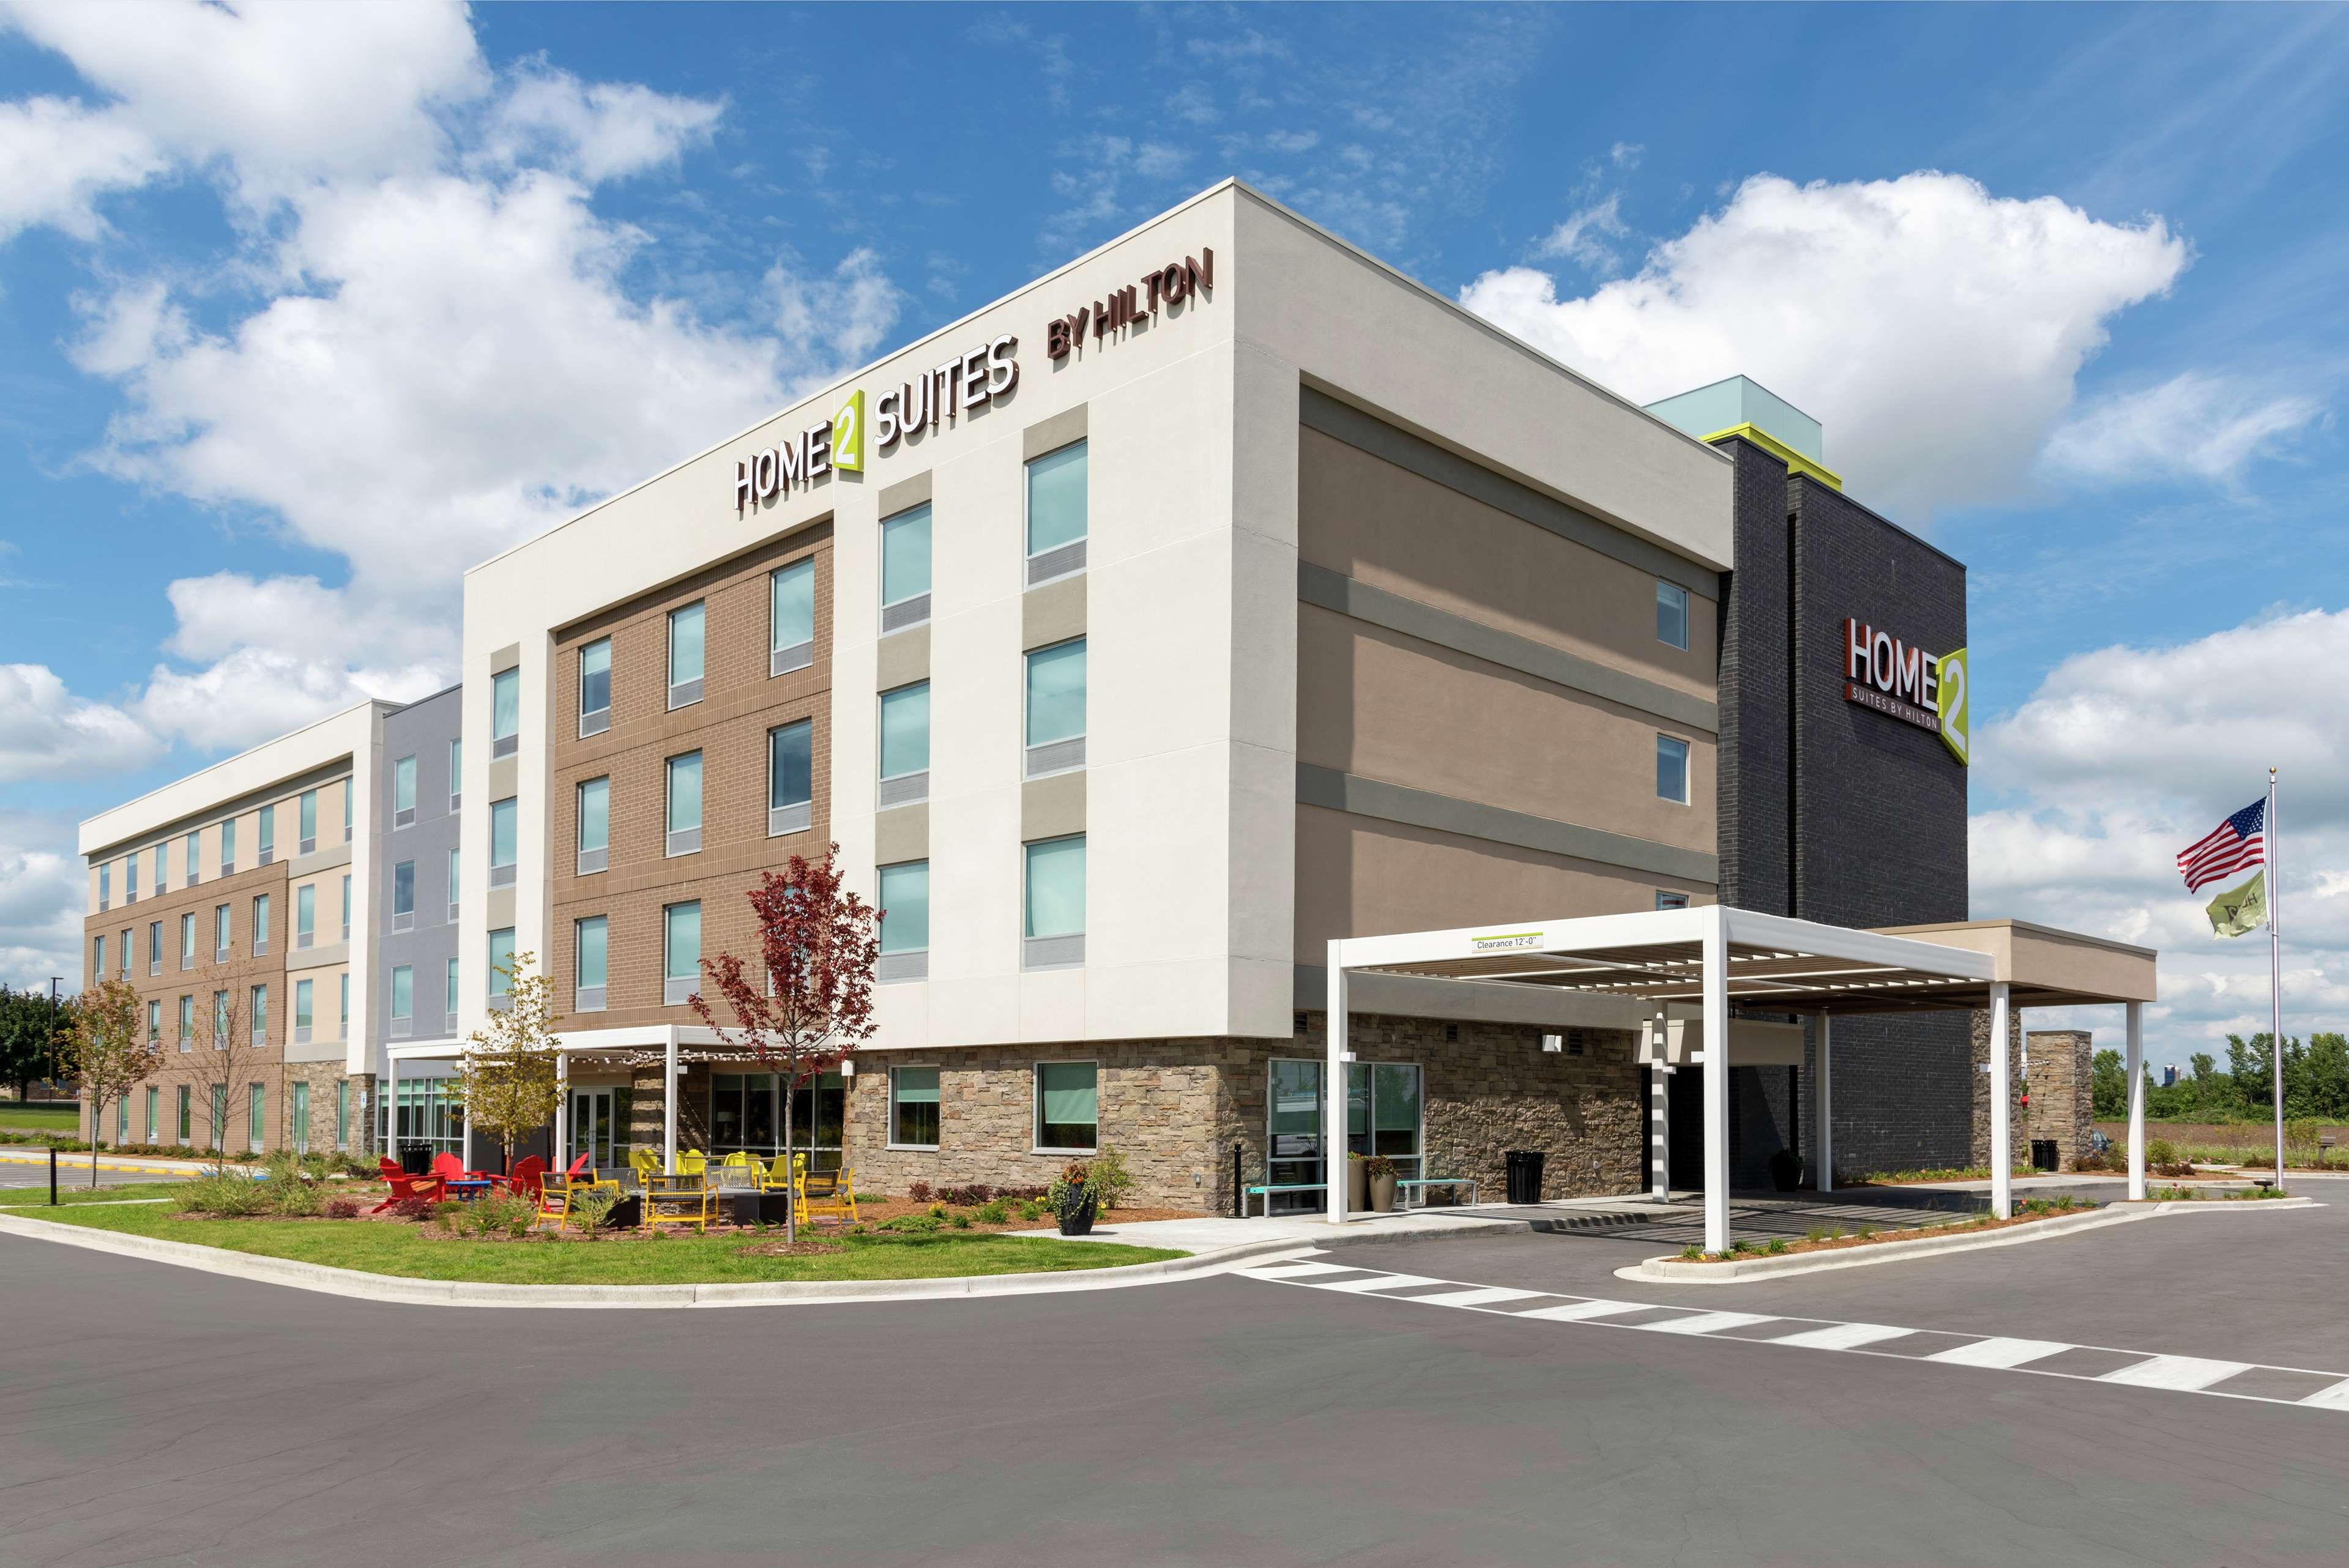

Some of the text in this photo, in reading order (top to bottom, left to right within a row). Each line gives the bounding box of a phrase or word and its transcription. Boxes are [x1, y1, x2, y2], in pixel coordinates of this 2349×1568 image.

[734, 247, 1214, 510] HOME 2 SUITES BY HILTON
[1847, 617, 1966, 754] HOME 2
[1852, 687, 1937, 729] SUITES BY HILTON
[1477, 940, 1513, 949] Clearance
